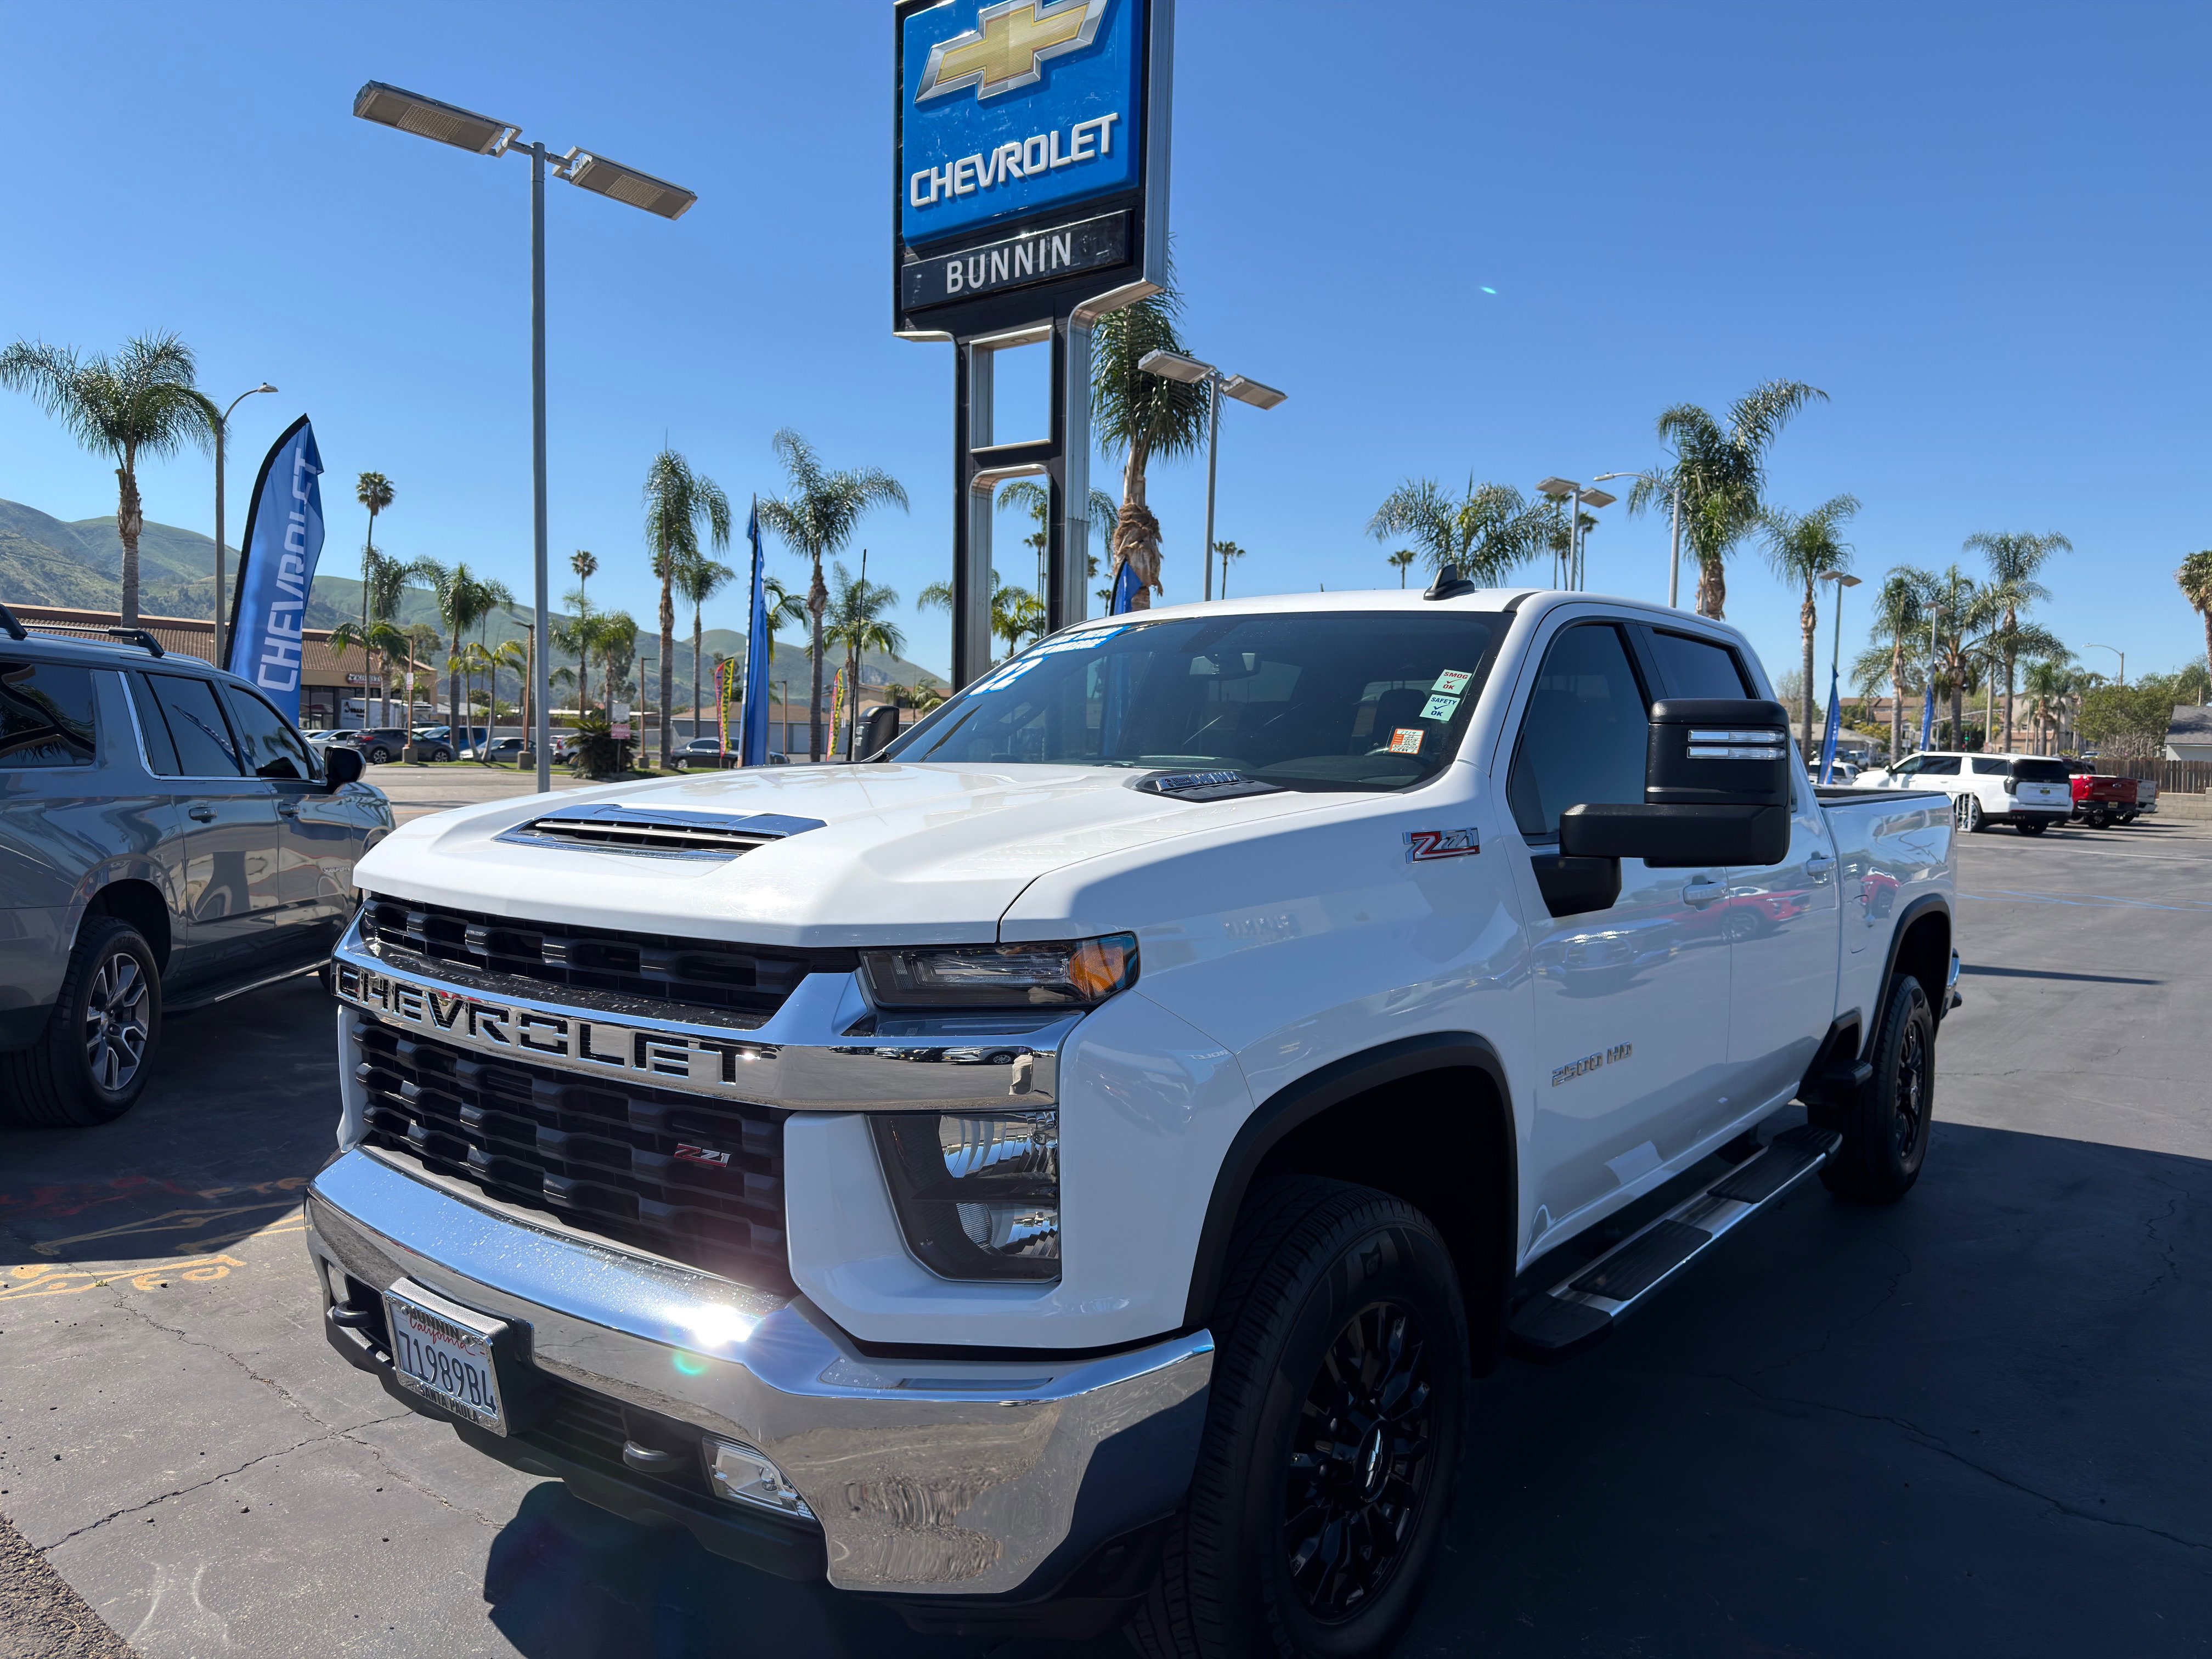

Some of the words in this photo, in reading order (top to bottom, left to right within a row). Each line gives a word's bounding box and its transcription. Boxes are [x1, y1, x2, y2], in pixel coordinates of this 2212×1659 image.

[911, 112, 1119, 207] CHEVROLET
[946, 233, 1071, 294] BUNNIN
[1431, 697, 1457, 705] SAFETY
[1402, 827, 1480, 864] Z71
[337, 964, 761, 1086] CHEVROLET
[1552, 1052, 1603, 1087] 2500
[1607, 1041, 1632, 1064] HD
[674, 1143, 731, 1167] Z71
[409, 1315, 475, 1356] California
[410, 1305, 460, 1340] BUNNIN
[399, 1330, 496, 1416] 71989B4
[419, 1382, 448, 1406] SANTA
[450, 1398, 480, 1424] PAULA
